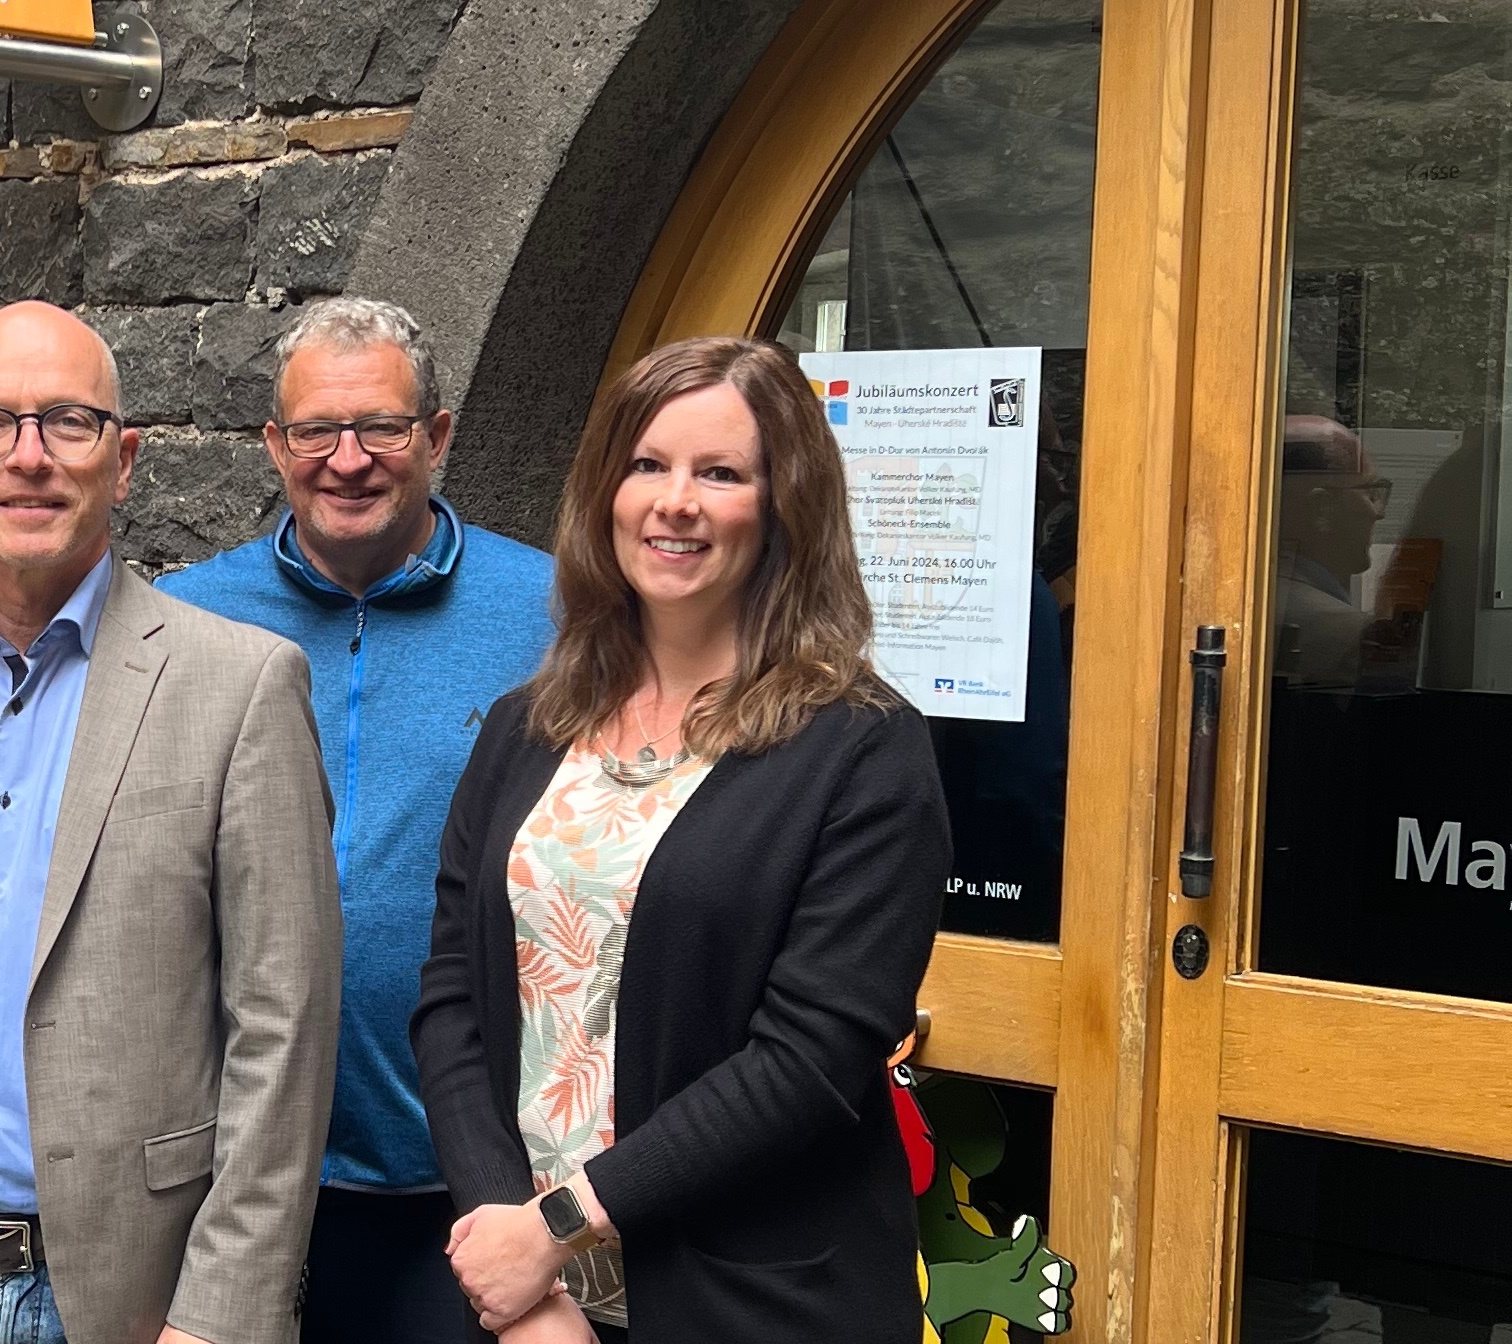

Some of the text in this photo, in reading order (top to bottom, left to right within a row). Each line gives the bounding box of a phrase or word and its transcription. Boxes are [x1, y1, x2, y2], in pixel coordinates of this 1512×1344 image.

[856, 384, 979, 398] Jubiläumskonzert
[856, 405, 977, 415] 30 Jahre Städtepartnerschaft
[864, 419, 892, 429] Mayen
[841, 446, 868, 454] Messe
[869, 445, 876, 454] in
[871, 473, 955, 483] Kammerchor Mayen
[887, 556, 909, 567] Juni
[911, 556, 942, 568] 2024,
[944, 558, 974, 568] 16.00
[976, 558, 997, 569] Uhr
[903, 573, 949, 585] Clemens
[951, 575, 988, 587] Mayen
[1395, 816, 1512, 891] Ma
[944, 877, 1023, 900] LP u. NRW
